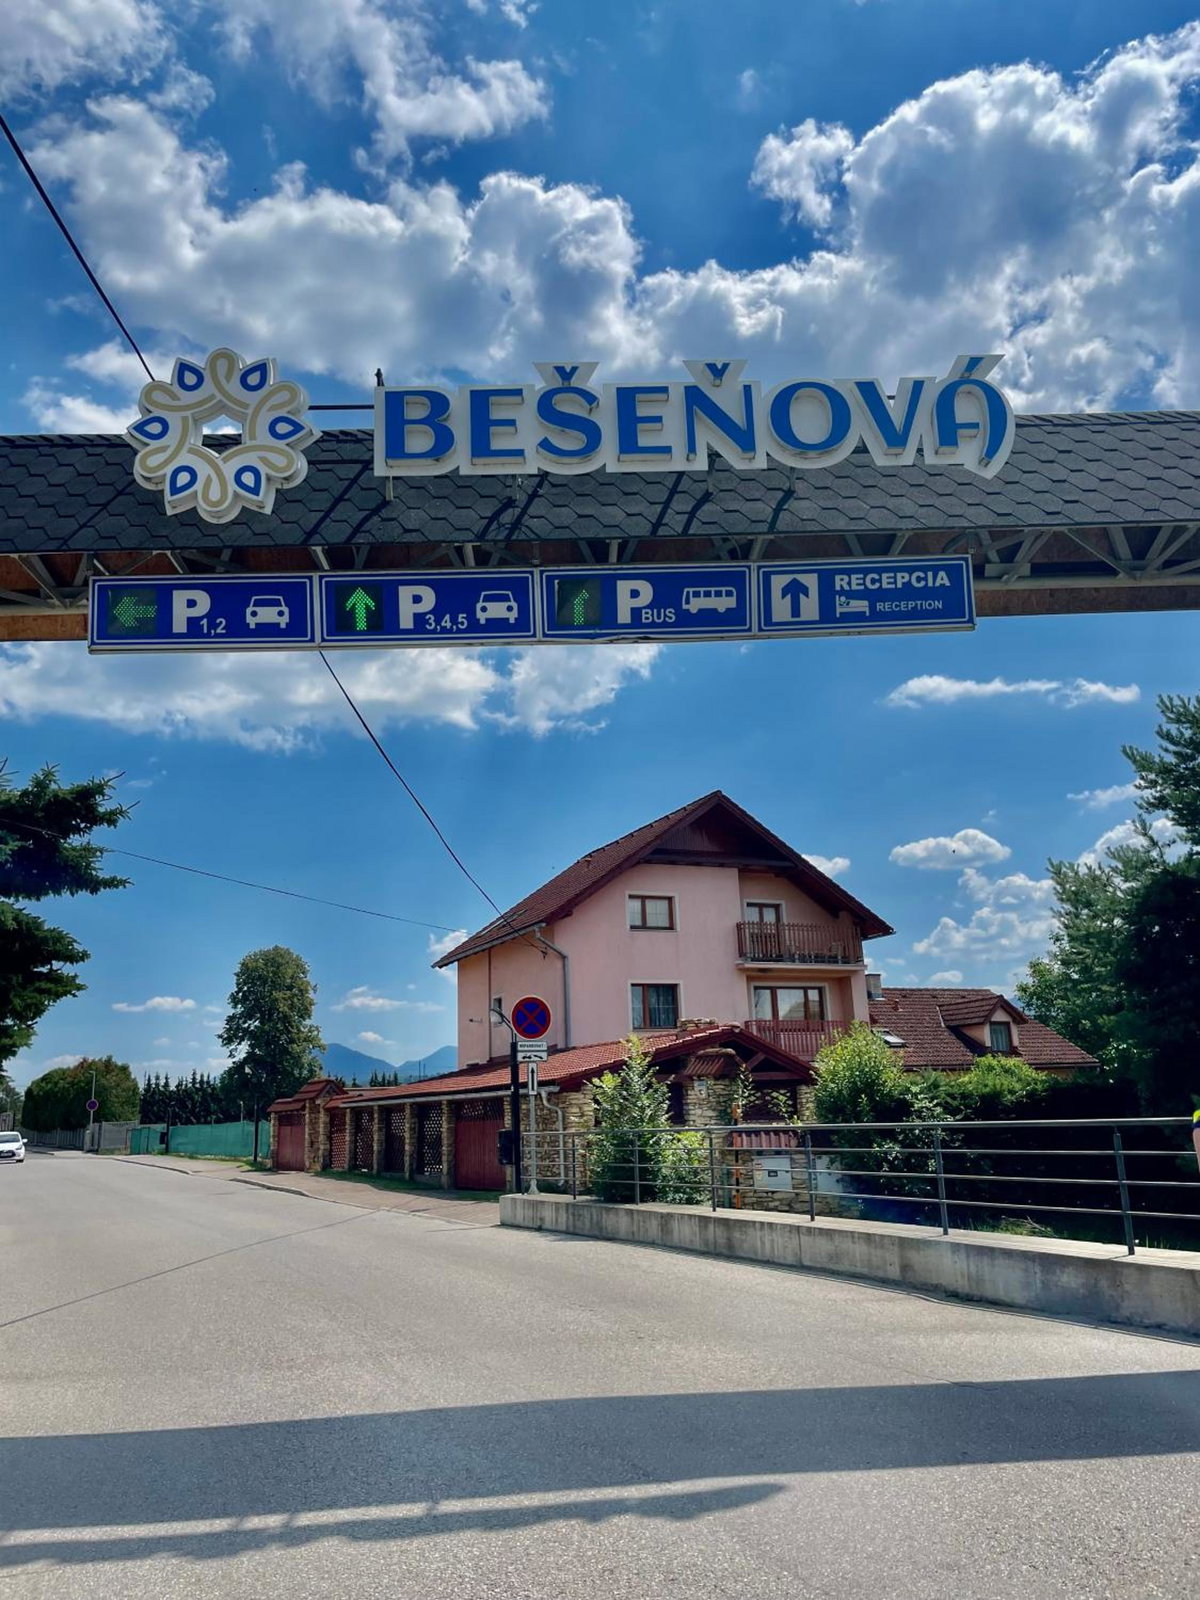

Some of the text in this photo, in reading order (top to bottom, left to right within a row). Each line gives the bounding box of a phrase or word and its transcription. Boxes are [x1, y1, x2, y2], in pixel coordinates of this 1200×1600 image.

[382, 356, 1009, 467] BEŠEŇOVÁ
[616, 579, 676, 624] P BUS
[834, 570, 951, 591] RECEPCIA
[172, 589, 227, 636] P 1,2
[398, 585, 468, 632] P 3,4,5
[876, 600, 943, 612] RECEPTION
